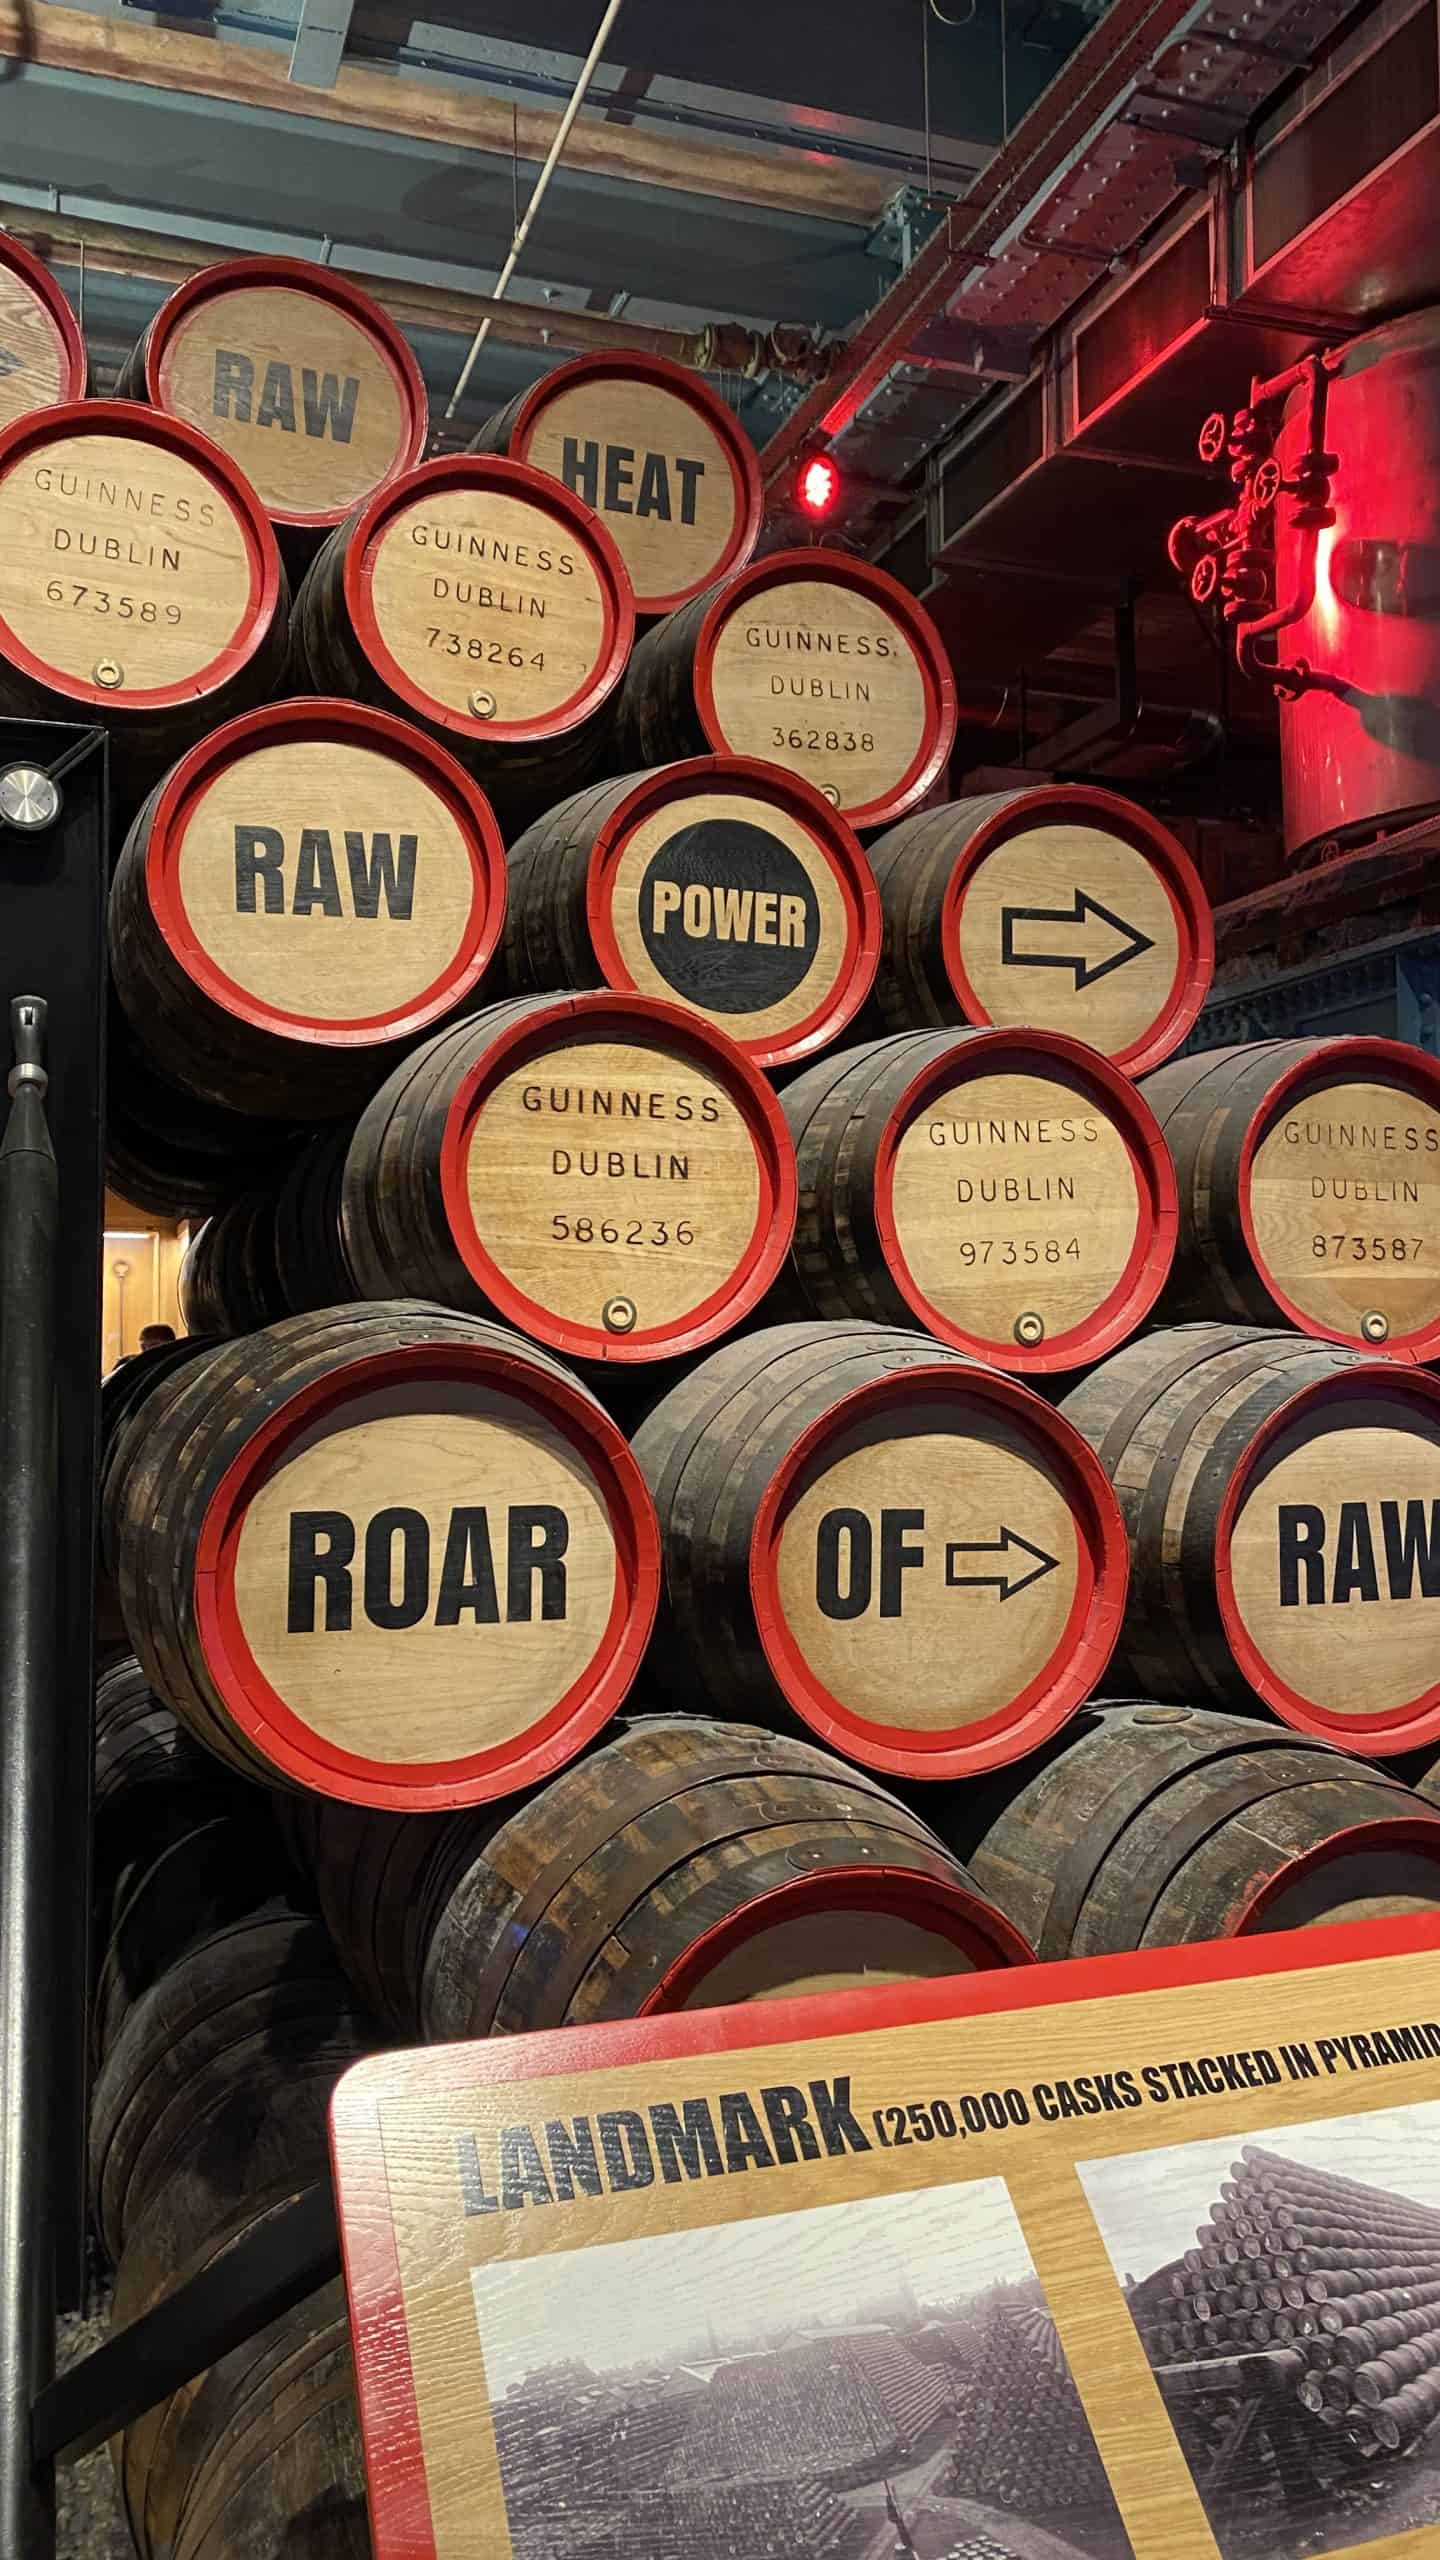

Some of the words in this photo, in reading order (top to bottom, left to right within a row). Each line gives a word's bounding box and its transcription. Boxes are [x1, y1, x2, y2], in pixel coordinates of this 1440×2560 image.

[211, 348, 361, 445] RAW
[34, 469, 216, 529] GUINNESS
[561, 437, 705, 526] HEAT
[53, 528, 182, 573] DUBLIN
[411, 524, 576, 577] GUINNESS
[46, 581, 183, 626] 673589
[432, 577, 547, 620] DUBLIN
[426, 627, 546, 673] 738264
[770, 674, 871, 703] DUBLIN
[771, 727, 875, 753] 362838
[234, 824, 419, 921] RAW
[652, 880, 808, 948] POWER
[521, 1085, 722, 1123] GUINNESS
[928, 1118, 1099, 1147] GUINNESS
[1284, 1120, 1440, 1152] GUINNESS
[551, 1149, 691, 1181] DUBLIN
[956, 1177, 1076, 1203] DUBLIN
[1311, 1176, 1420, 1203] DUBLIN
[550, 1214, 695, 1247] 586236
[958, 1237, 1082, 1267] 973584
[1311, 1236, 1425, 1262] 873587
[287, 1504, 570, 1634] ROAR
[815, 1507, 926, 1621] OF
[1278, 1500, 1440, 1607] RAW
[455, 2075, 874, 2217] LANDMARK
[872, 2088, 1032, 2147] (250,000
[1031, 2070, 1143, 2122] CASKS
[1141, 2049, 1283, 2098] STACKED
[1278, 2042, 1320, 2081] IN
